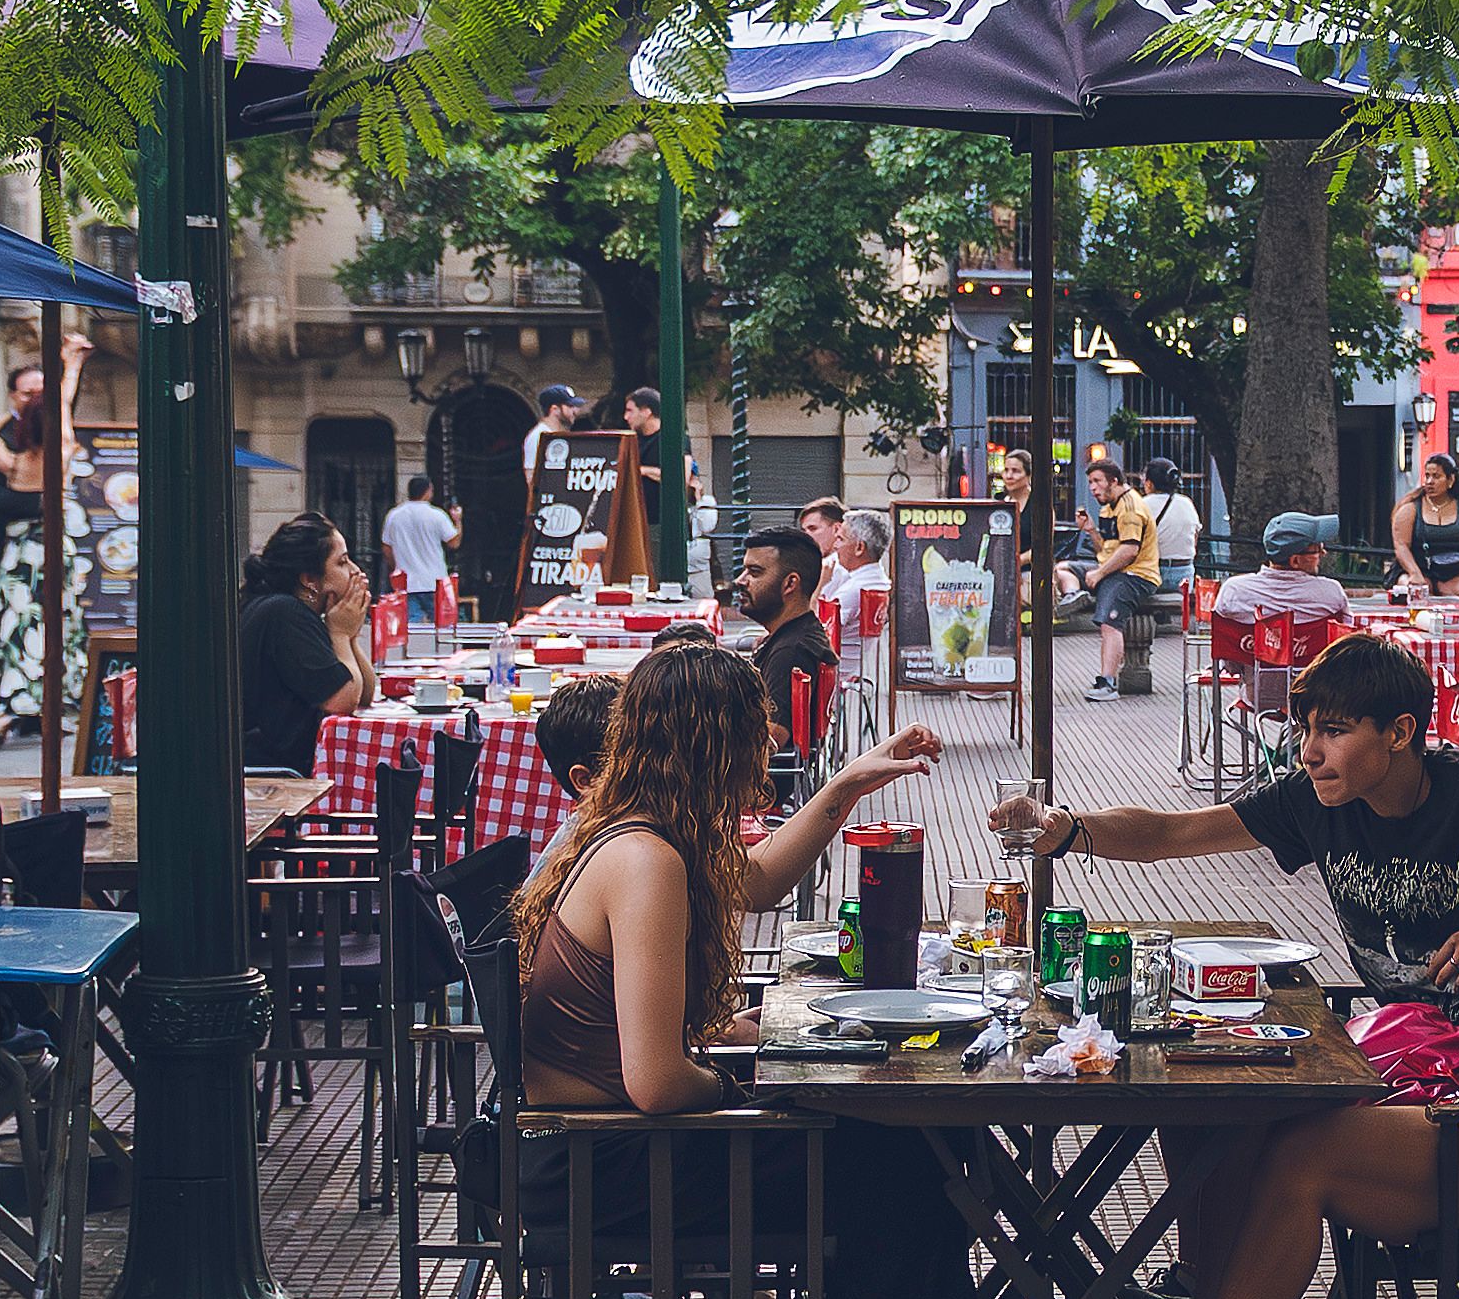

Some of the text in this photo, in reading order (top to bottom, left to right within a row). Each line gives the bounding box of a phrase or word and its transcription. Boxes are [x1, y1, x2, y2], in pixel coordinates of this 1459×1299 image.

[570, 457, 607, 471] HAPPY
[566, 470, 619, 492] HOUR
[899, 508, 968, 526] PROMO
[530, 561, 605, 585] TIRADA
